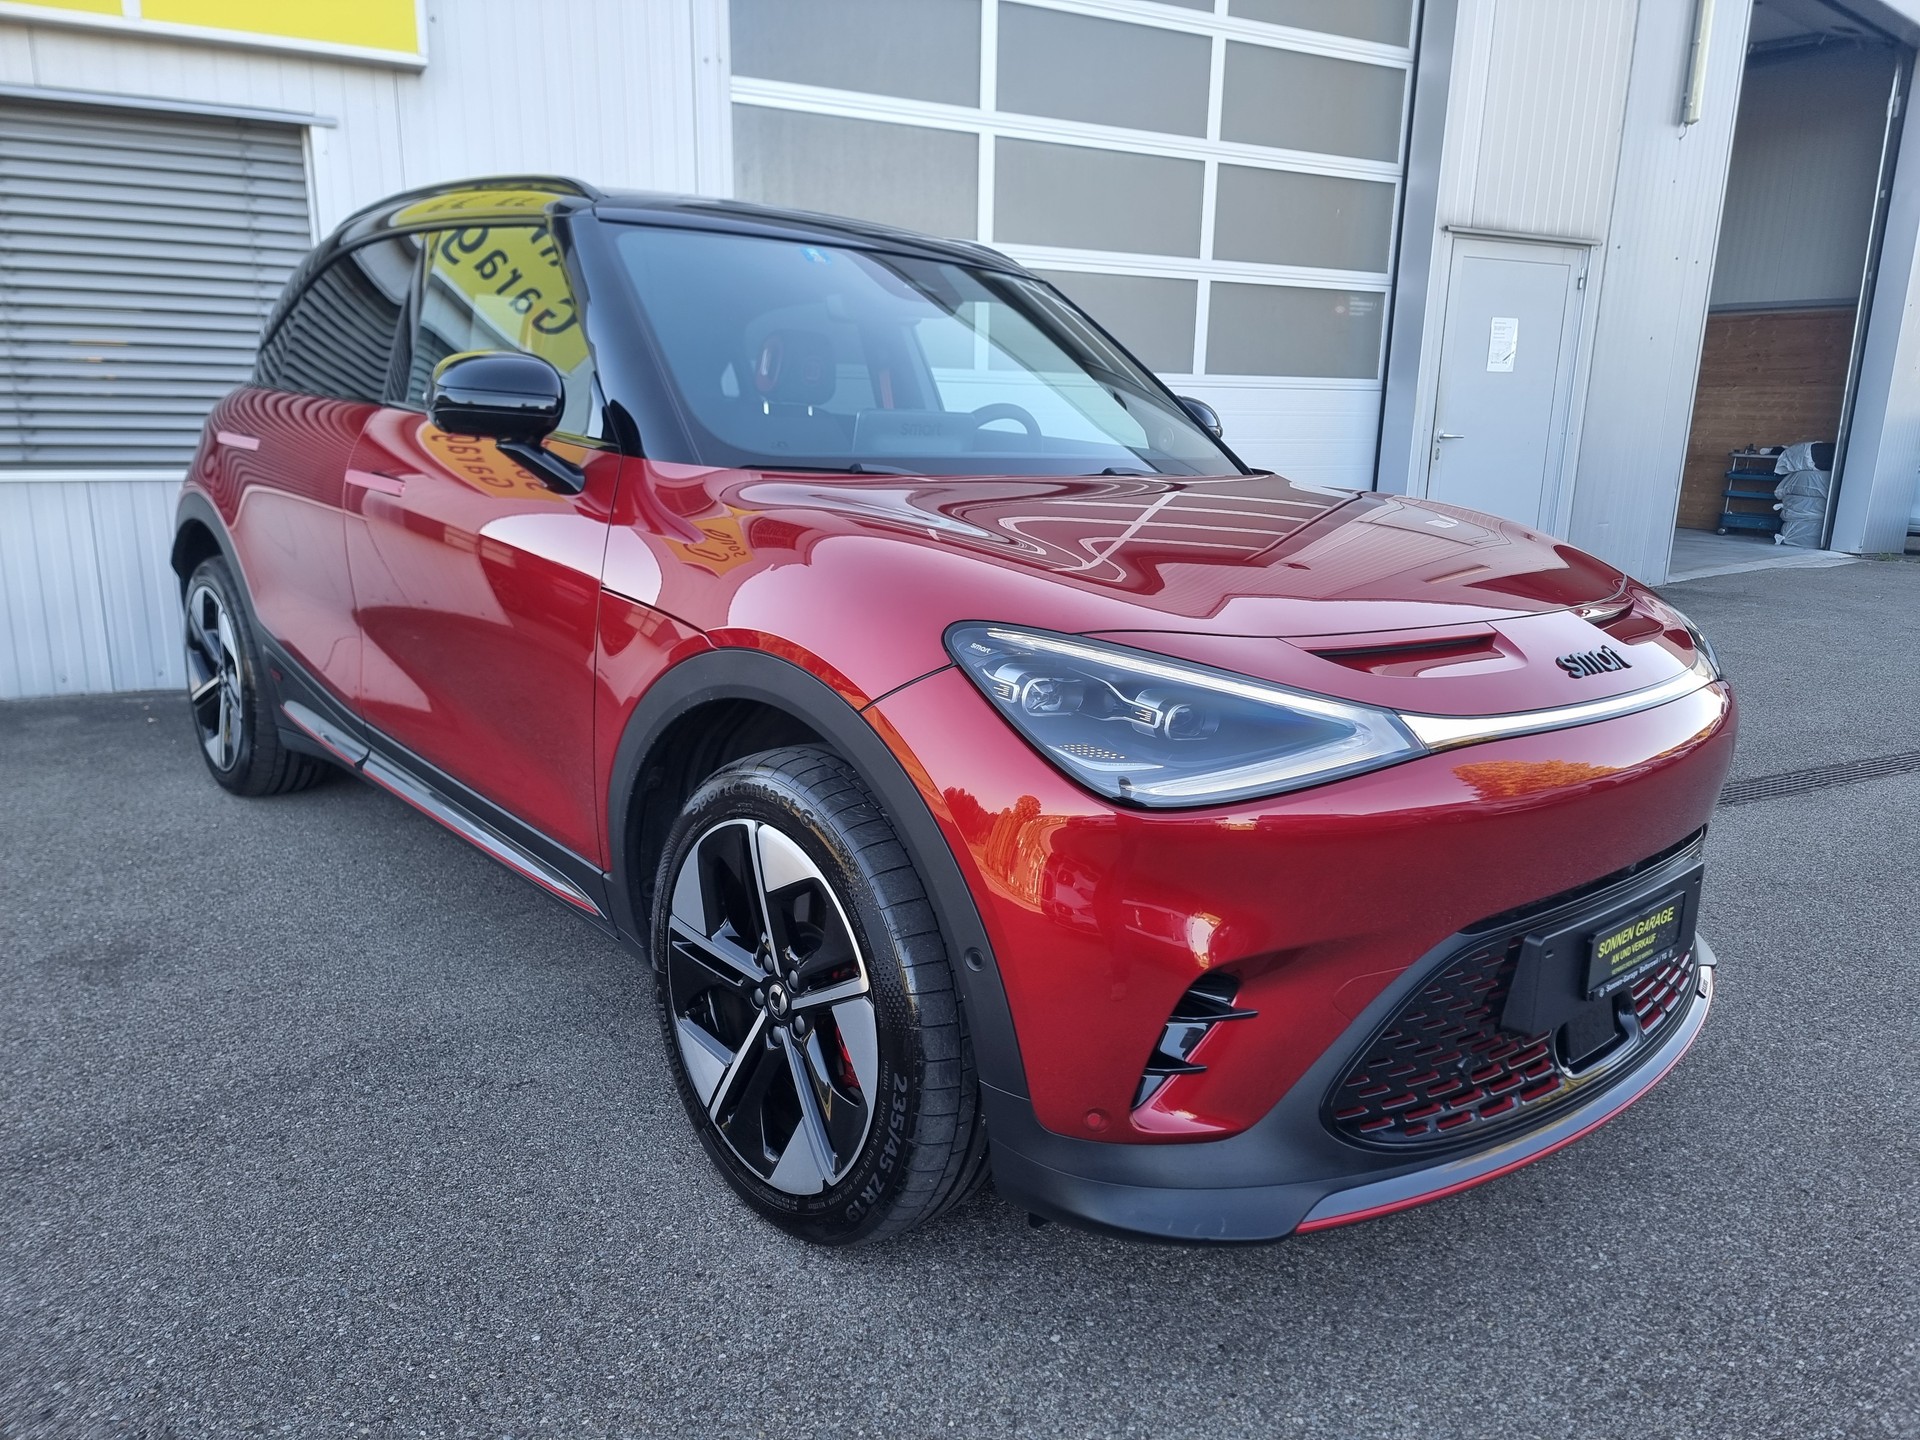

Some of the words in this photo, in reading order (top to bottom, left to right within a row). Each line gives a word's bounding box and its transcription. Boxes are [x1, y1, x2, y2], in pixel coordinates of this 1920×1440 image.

[970, 642, 991, 654] smart
[1555, 645, 1632, 679] smart
[1598, 926, 1635, 958] SONNEN
[1635, 906, 1675, 937] GARAGE
[1611, 953, 1621, 965] AN
[1620, 946, 1632, 960] UND
[1631, 933, 1657, 954] VERKAUF
[879, 1073, 908, 1174] 235/45
